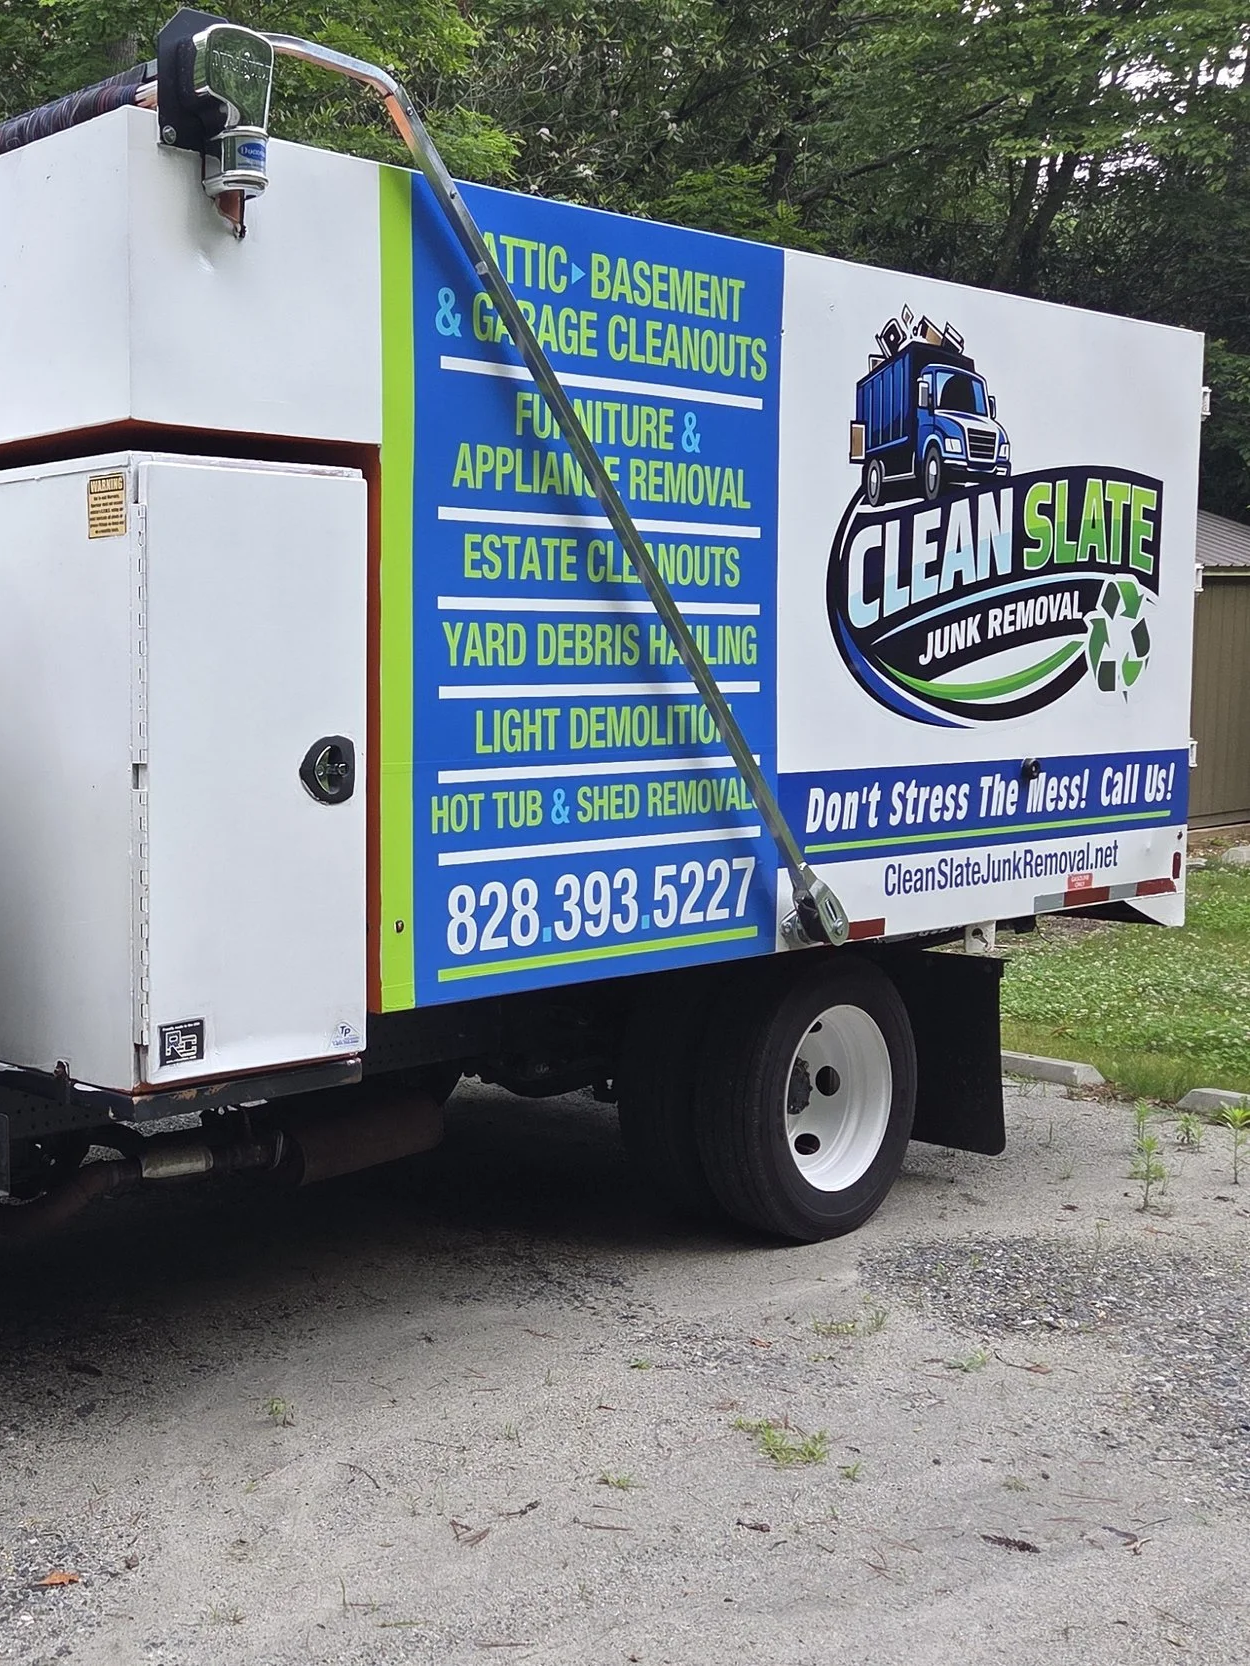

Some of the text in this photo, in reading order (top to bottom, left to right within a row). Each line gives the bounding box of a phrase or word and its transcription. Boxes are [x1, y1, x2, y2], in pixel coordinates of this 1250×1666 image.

[591, 253, 745, 322] BASEMENT
[435, 287, 461, 337] &
[608, 314, 767, 381] CLEANOUTS
[516, 392, 701, 453] FUNITURE &
[629, 458, 751, 509] REMOVAL
[464, 533, 577, 581] ESTATE
[847, 478, 1157, 629] CLEAN SLATE
[443, 622, 526, 667] YARD
[537, 622, 639, 666] DEBRIS
[918, 590, 1083, 666] JUNK REMOVAL
[475, 703, 731, 753] LIGHT DEMOLITIO
[431, 777, 758, 834] HOT TUB & SHED REMOVAL
[805, 762, 1176, 833] Don't Stress The Mess! Call Us!
[884, 839, 1119, 897] CleanSlateJunkRemoval.net
[446, 856, 756, 955] 828.393.5227
